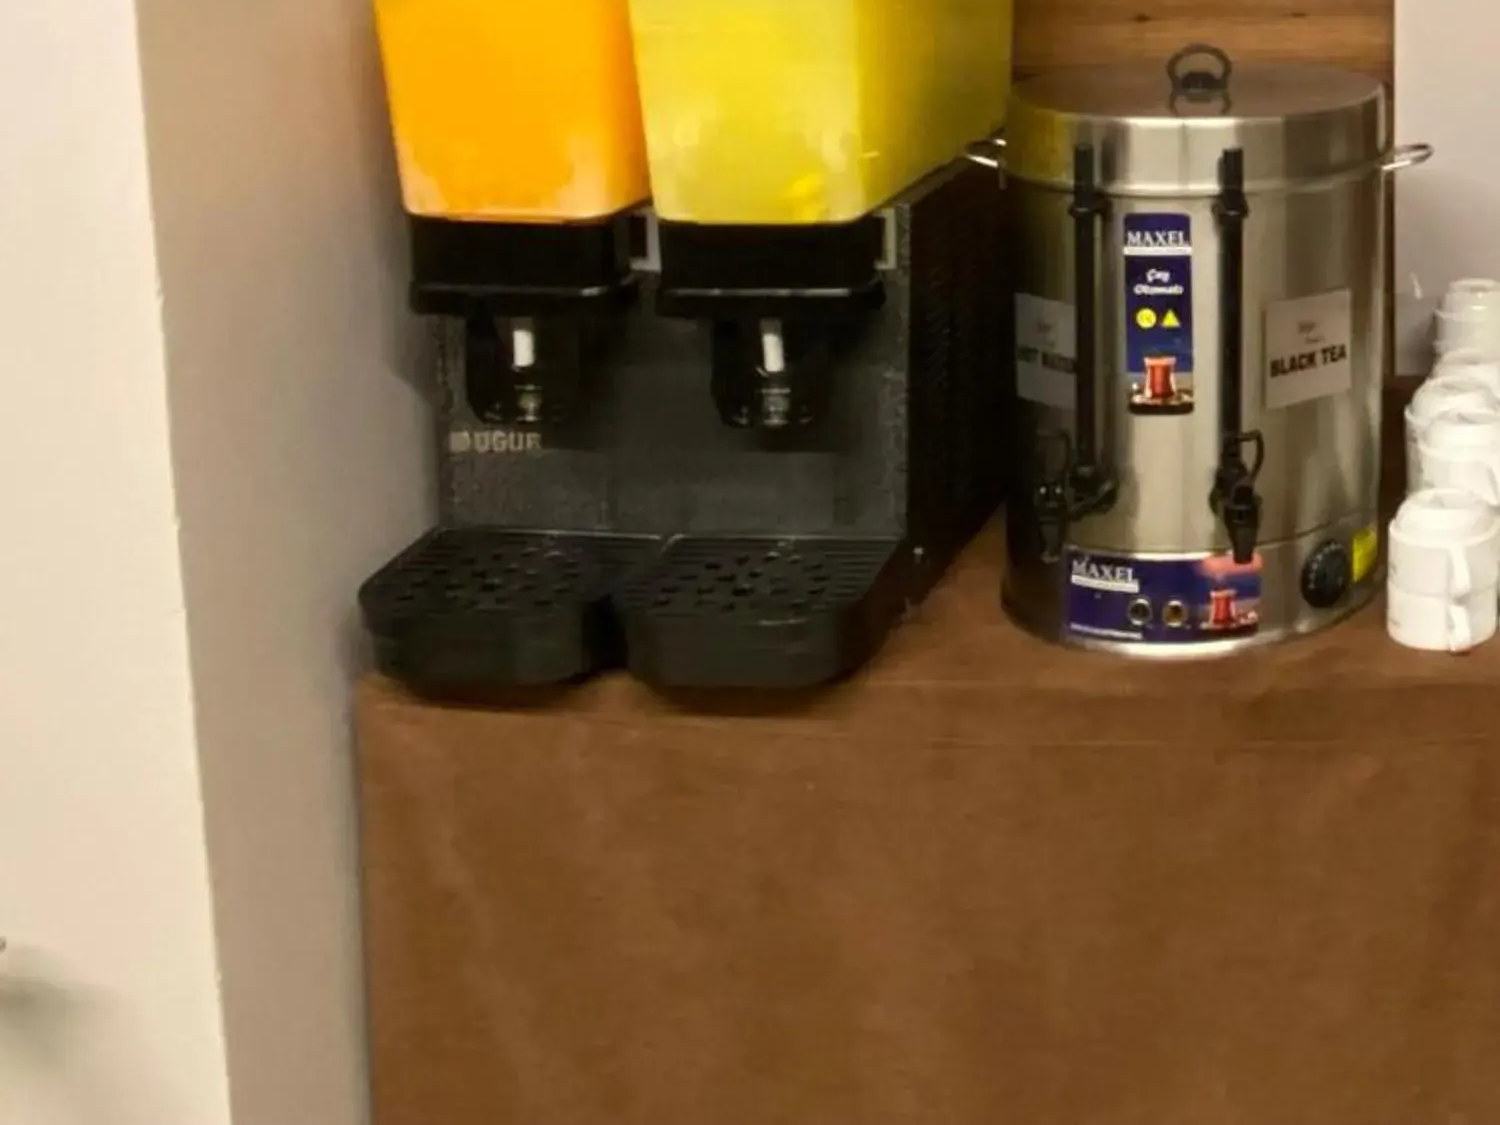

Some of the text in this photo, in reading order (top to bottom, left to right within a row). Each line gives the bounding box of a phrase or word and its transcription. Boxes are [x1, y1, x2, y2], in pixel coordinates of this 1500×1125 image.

[1126, 230, 1188, 247] MAXEL
[1270, 343, 1347, 378] BLACK TEA
[1072, 559, 1137, 582] MAXEL
